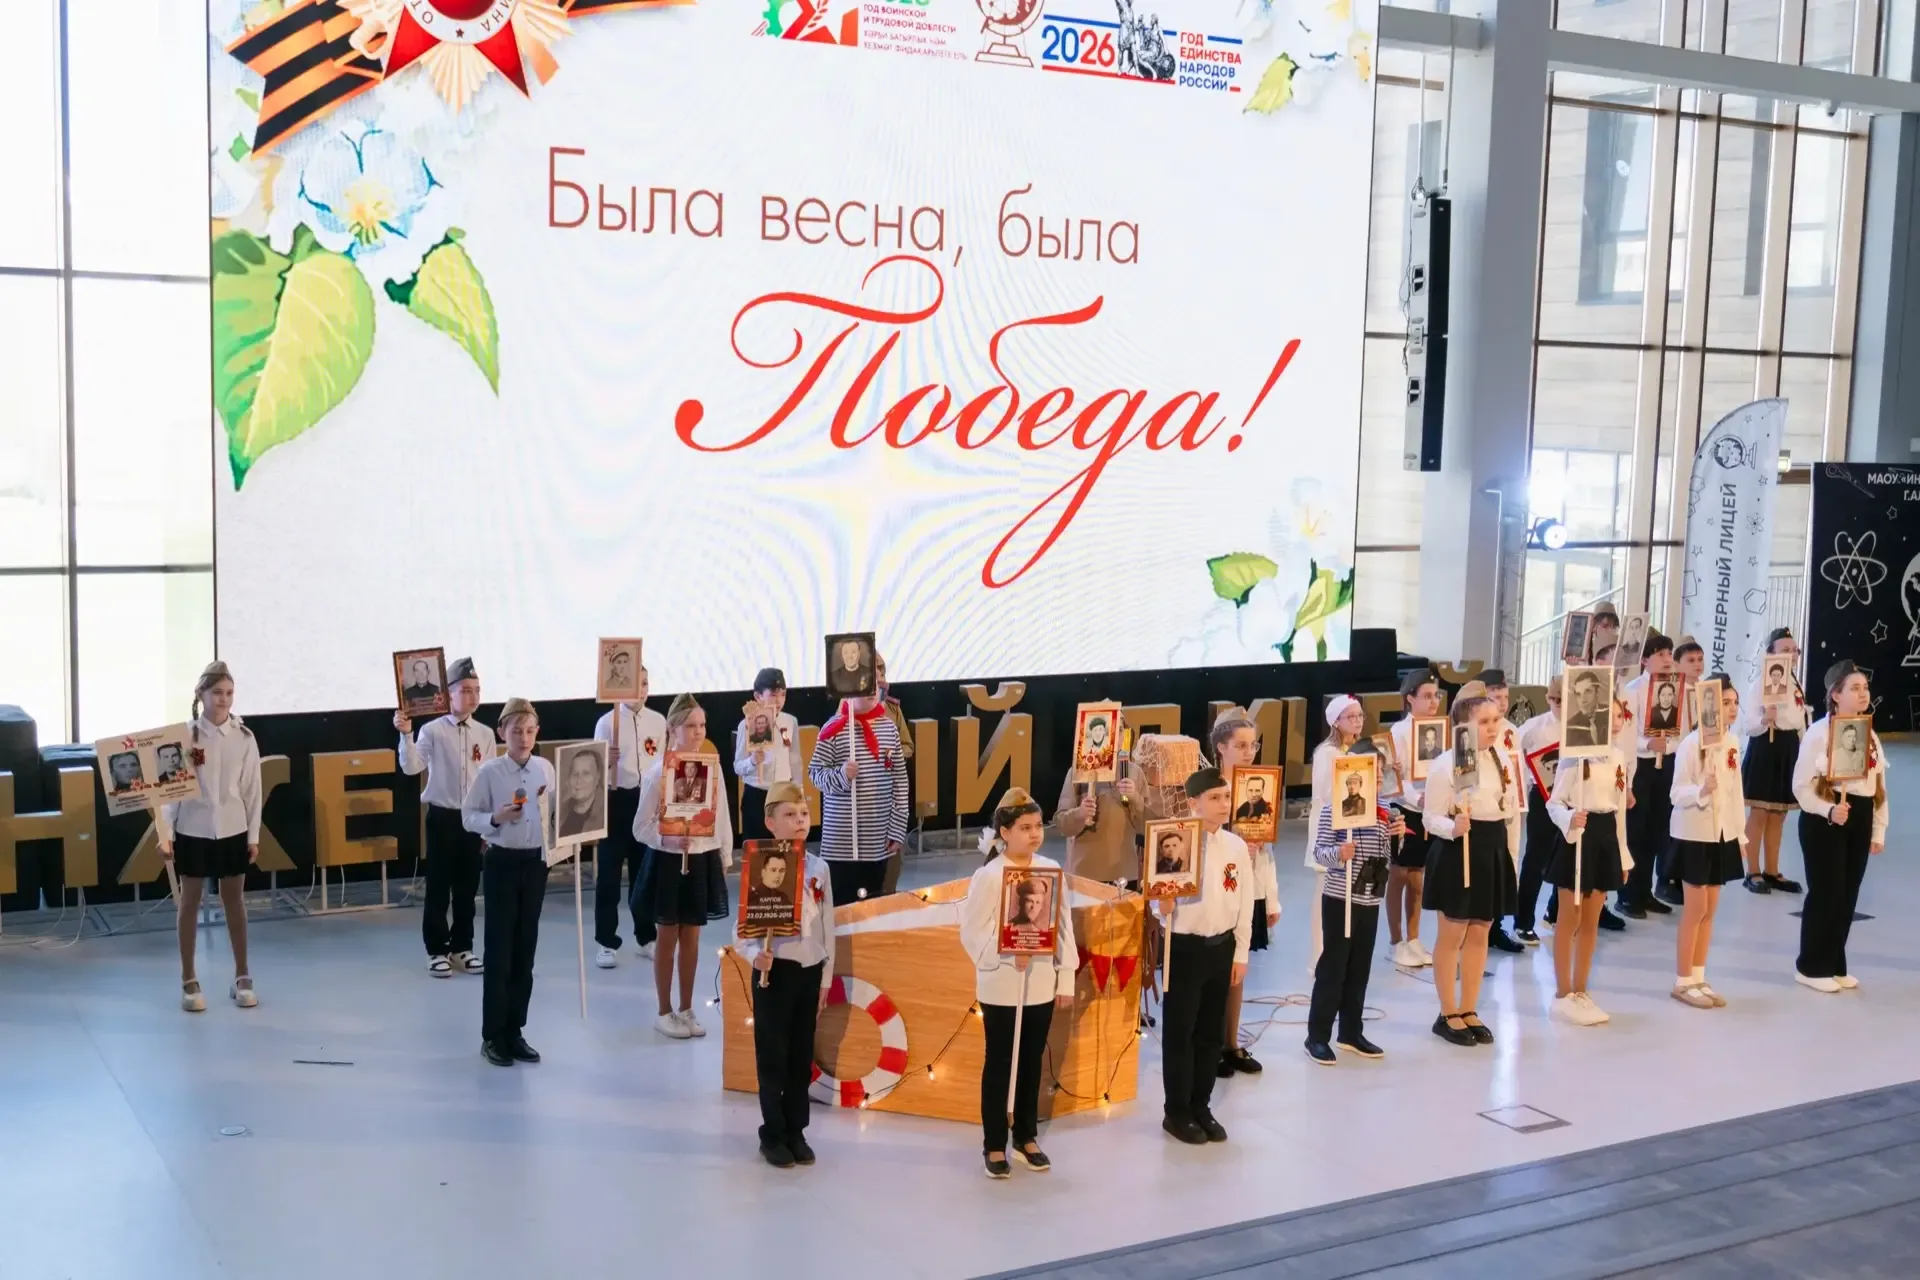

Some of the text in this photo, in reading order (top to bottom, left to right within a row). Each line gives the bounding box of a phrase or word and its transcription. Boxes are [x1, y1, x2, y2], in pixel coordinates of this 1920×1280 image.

[863, 4, 880, 13] ГОД
[871, 16, 914, 29] ТРУДОВОЙ
[915, 22, 957, 33] ДОБЛЕСТИ
[1041, 25, 1116, 67] 2026
[1180, 32, 1204, 47] ГОД
[1179, 47, 1242, 65] ЕДИНСТВА
[1179, 62, 1236, 78] НАРОДОВ
[1179, 76, 1228, 91] РОССИИ
[548, 147, 1140, 268] Была весна, была
[674, 254, 1301, 590] Победа!
[1867, 472, 1899, 485] МАОУ
[1711, 483, 1738, 675] ЖЕНЕРНЫЙ ЛИЦЕЙ
